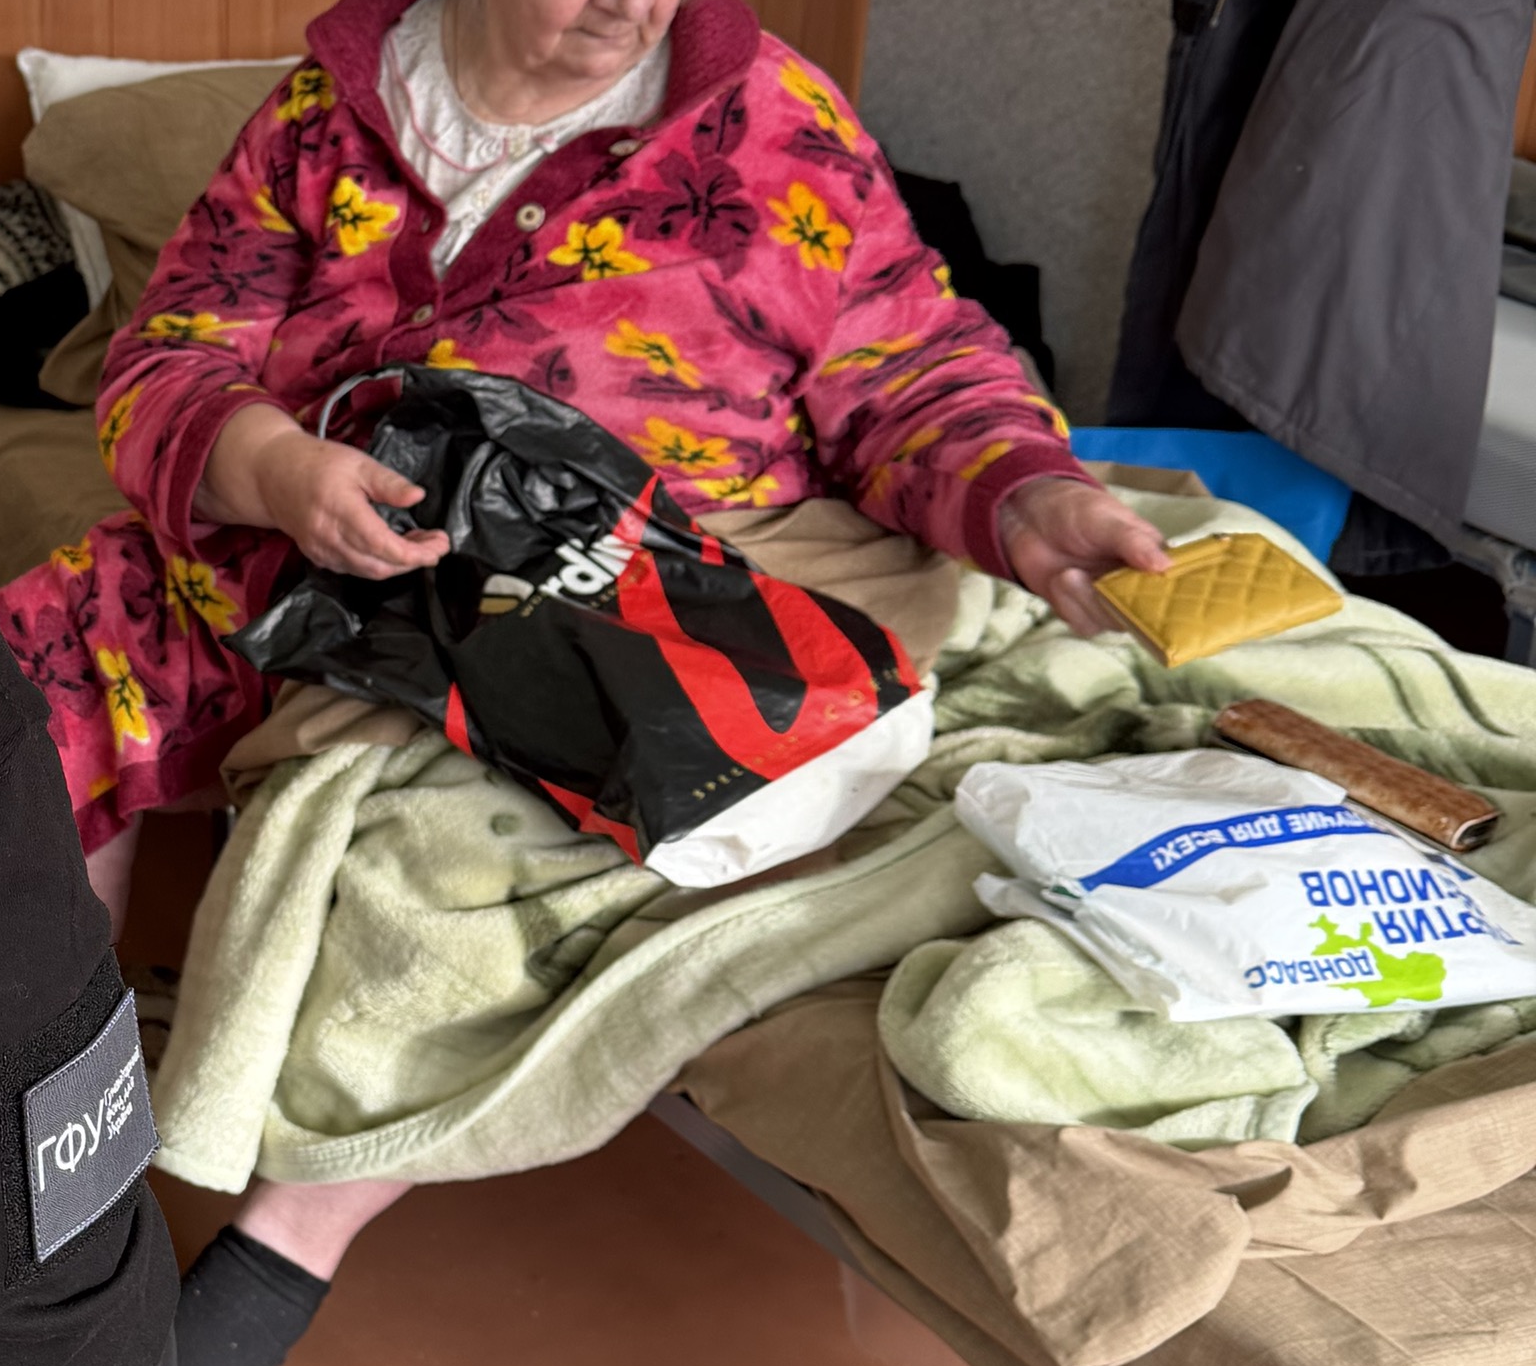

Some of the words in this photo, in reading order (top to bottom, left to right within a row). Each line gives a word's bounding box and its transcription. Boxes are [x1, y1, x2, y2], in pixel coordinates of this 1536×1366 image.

[1227, 814, 1283, 843] ДЛЯ
[1149, 829, 1228, 871] ВСЕХ!
[1299, 868, 1445, 907] ИОНОВ
[1372, 905, 1488, 945] РТИЯ
[1244, 948, 1375, 989] ДОНБАСС
[37, 1098, 104, 1192] ГФУ
